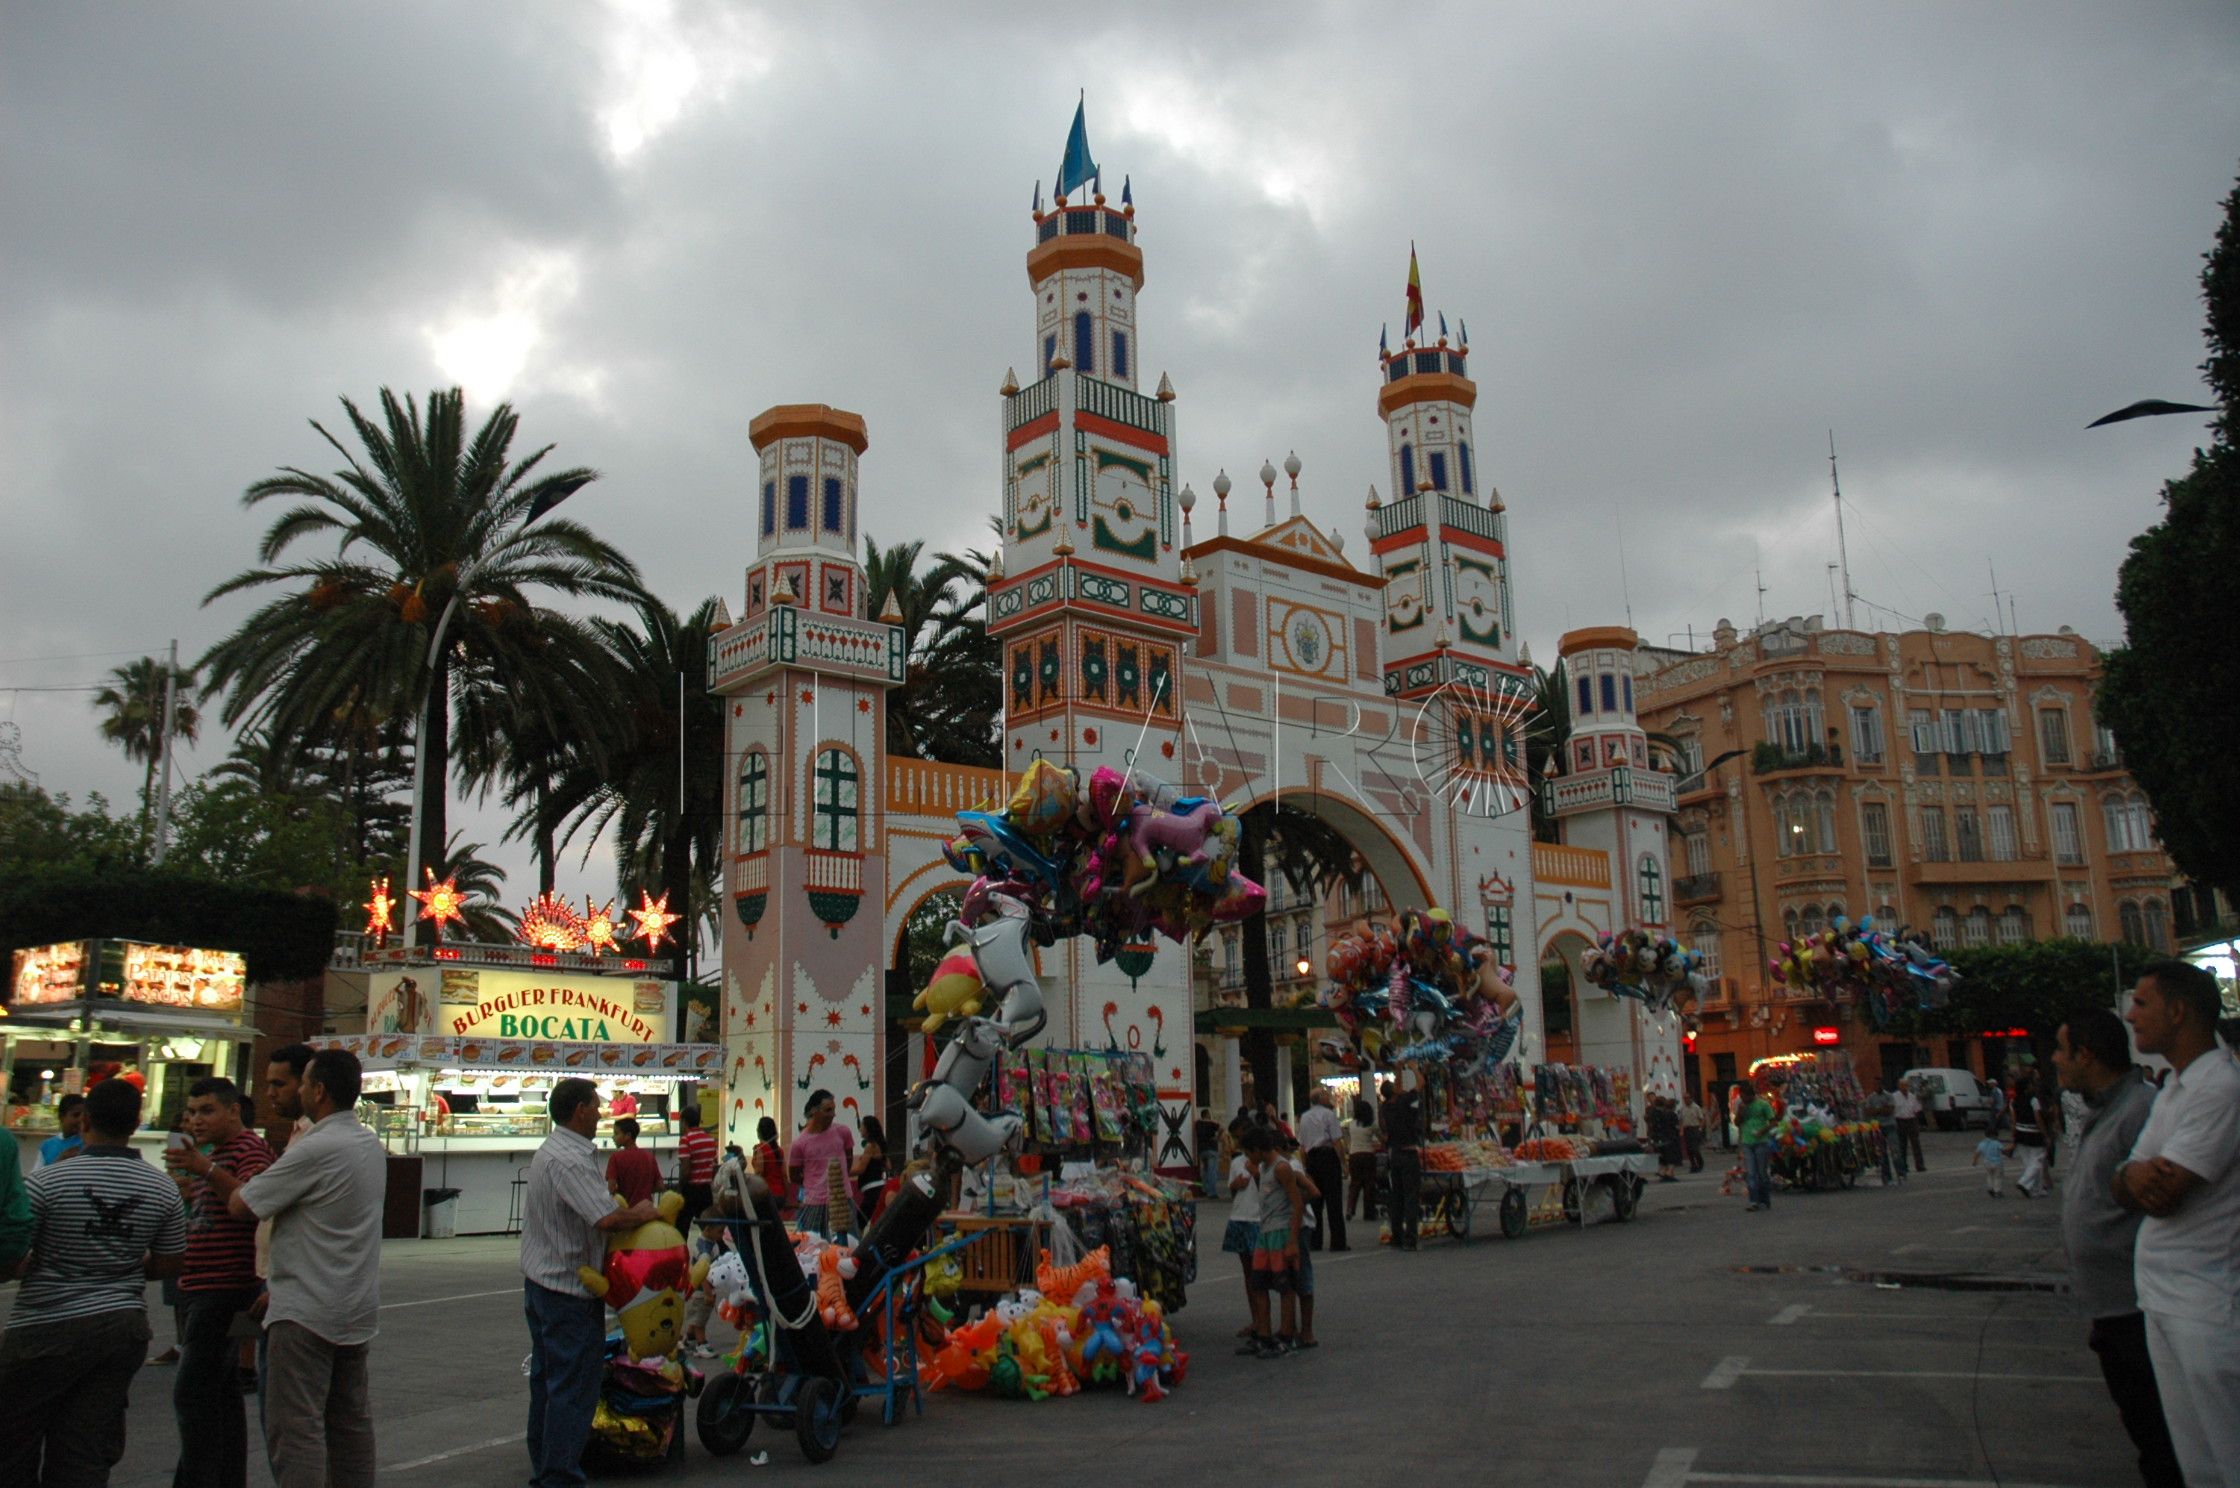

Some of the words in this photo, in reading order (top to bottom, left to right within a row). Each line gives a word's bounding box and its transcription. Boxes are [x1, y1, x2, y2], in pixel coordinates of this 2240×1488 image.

[453, 988, 545, 1036] BURGUER
[550, 988, 655, 1042] FRANKFURT
[501, 1014, 610, 1041] BOCATA
